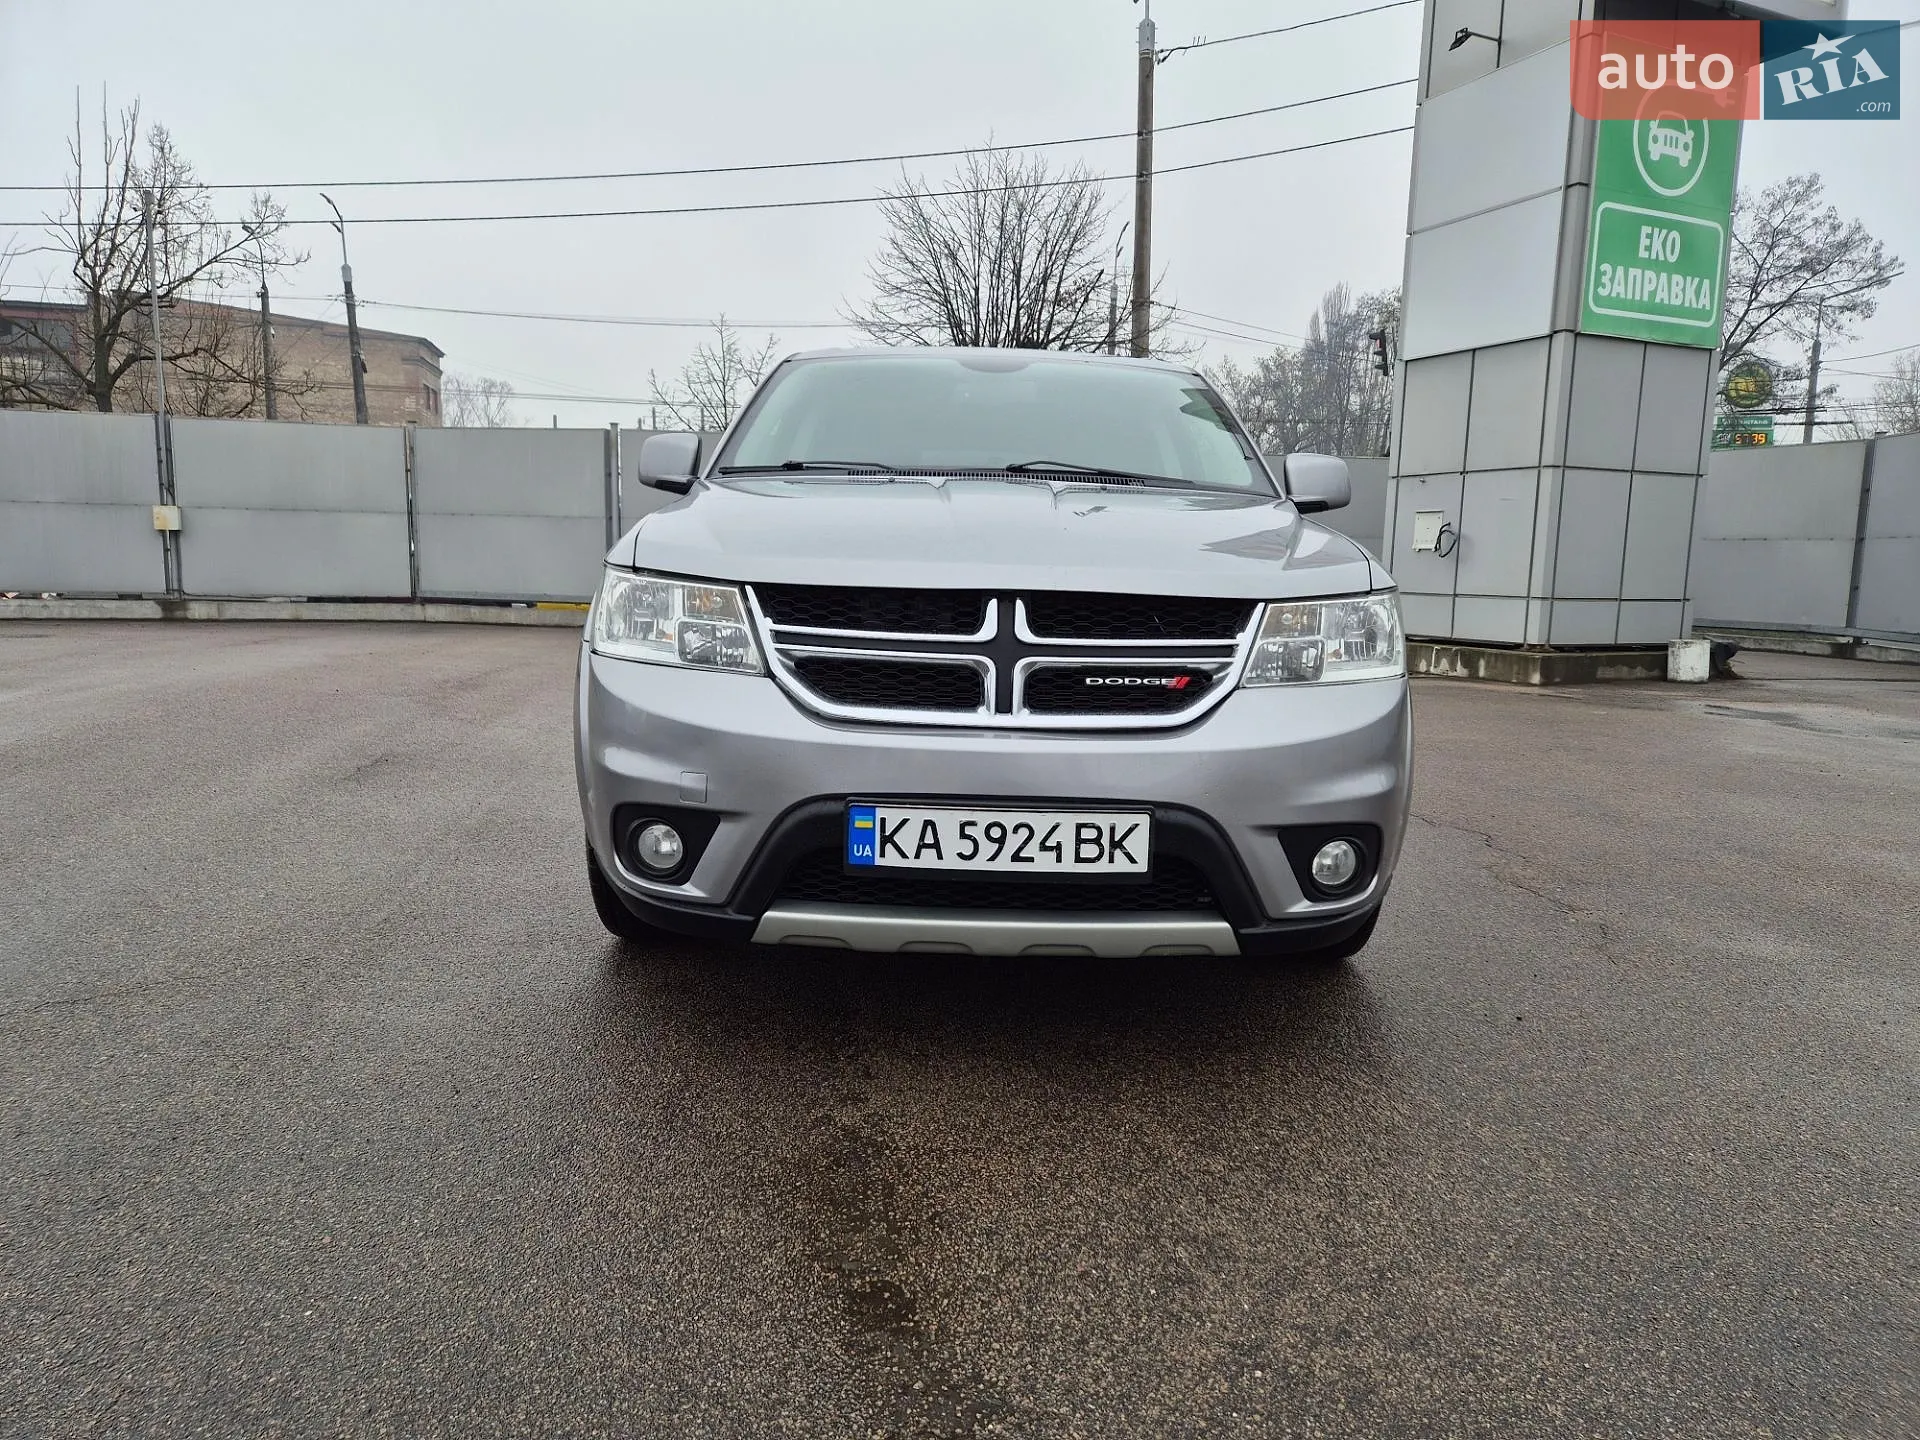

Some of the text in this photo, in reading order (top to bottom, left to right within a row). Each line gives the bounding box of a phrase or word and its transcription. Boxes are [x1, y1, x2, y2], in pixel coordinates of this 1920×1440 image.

[1638, 225, 1681, 263] ЕКО
[1597, 264, 1711, 310] ЗАПРАВКА
[1085, 677, 1177, 686] DODGE
[853, 844, 873, 857] UA
[878, 817, 944, 860] KA
[956, 820, 1063, 863] 5924
